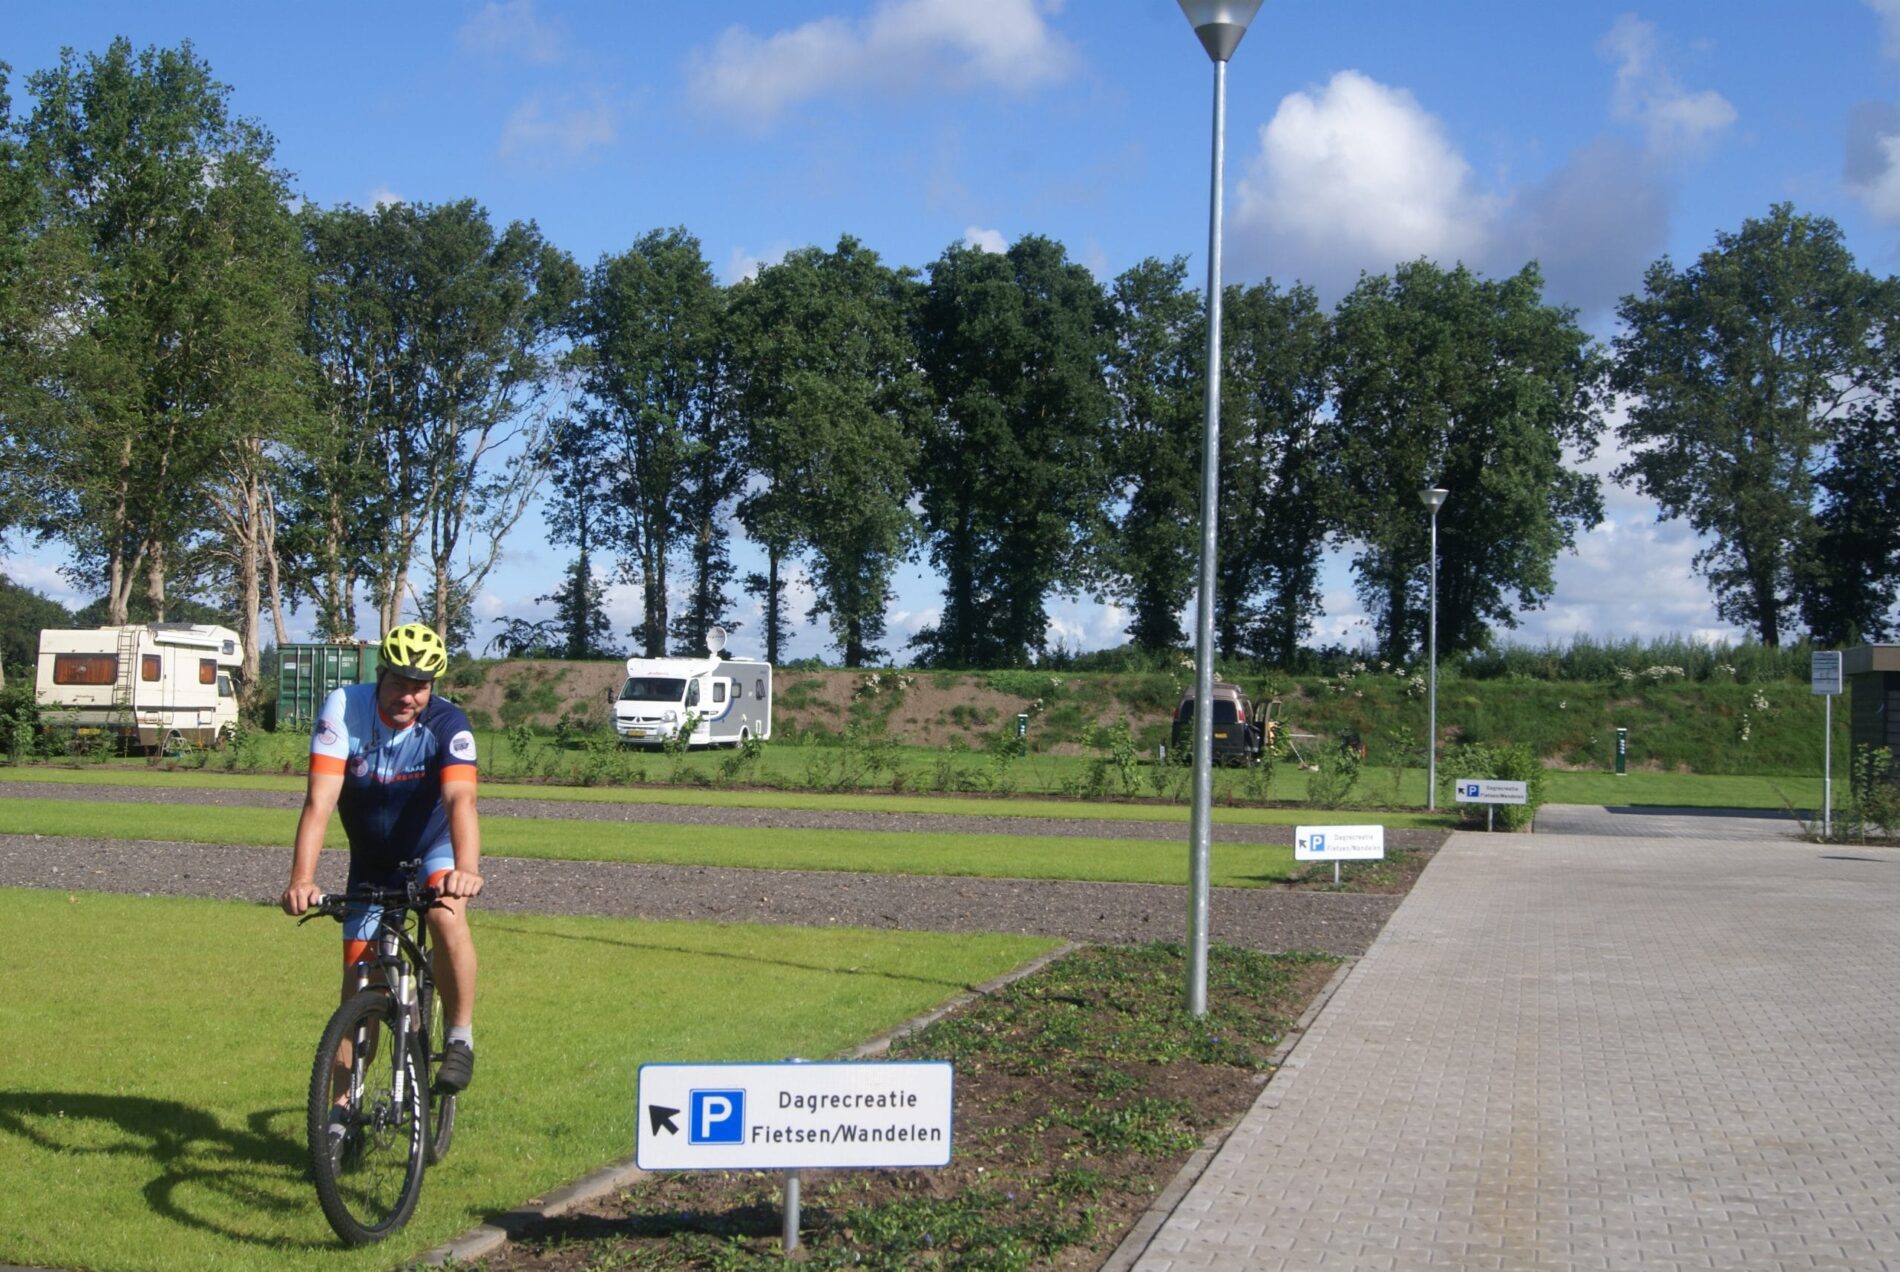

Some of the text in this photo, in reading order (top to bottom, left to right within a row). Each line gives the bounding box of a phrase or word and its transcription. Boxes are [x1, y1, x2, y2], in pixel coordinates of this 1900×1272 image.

[1469, 786, 1477, 796] P
[1313, 836, 1322, 850] P
[779, 1091, 918, 1114] Dagrecreatie
[702, 1096, 733, 1138] P
[752, 1124, 942, 1144] Fietsen/Wandelen
